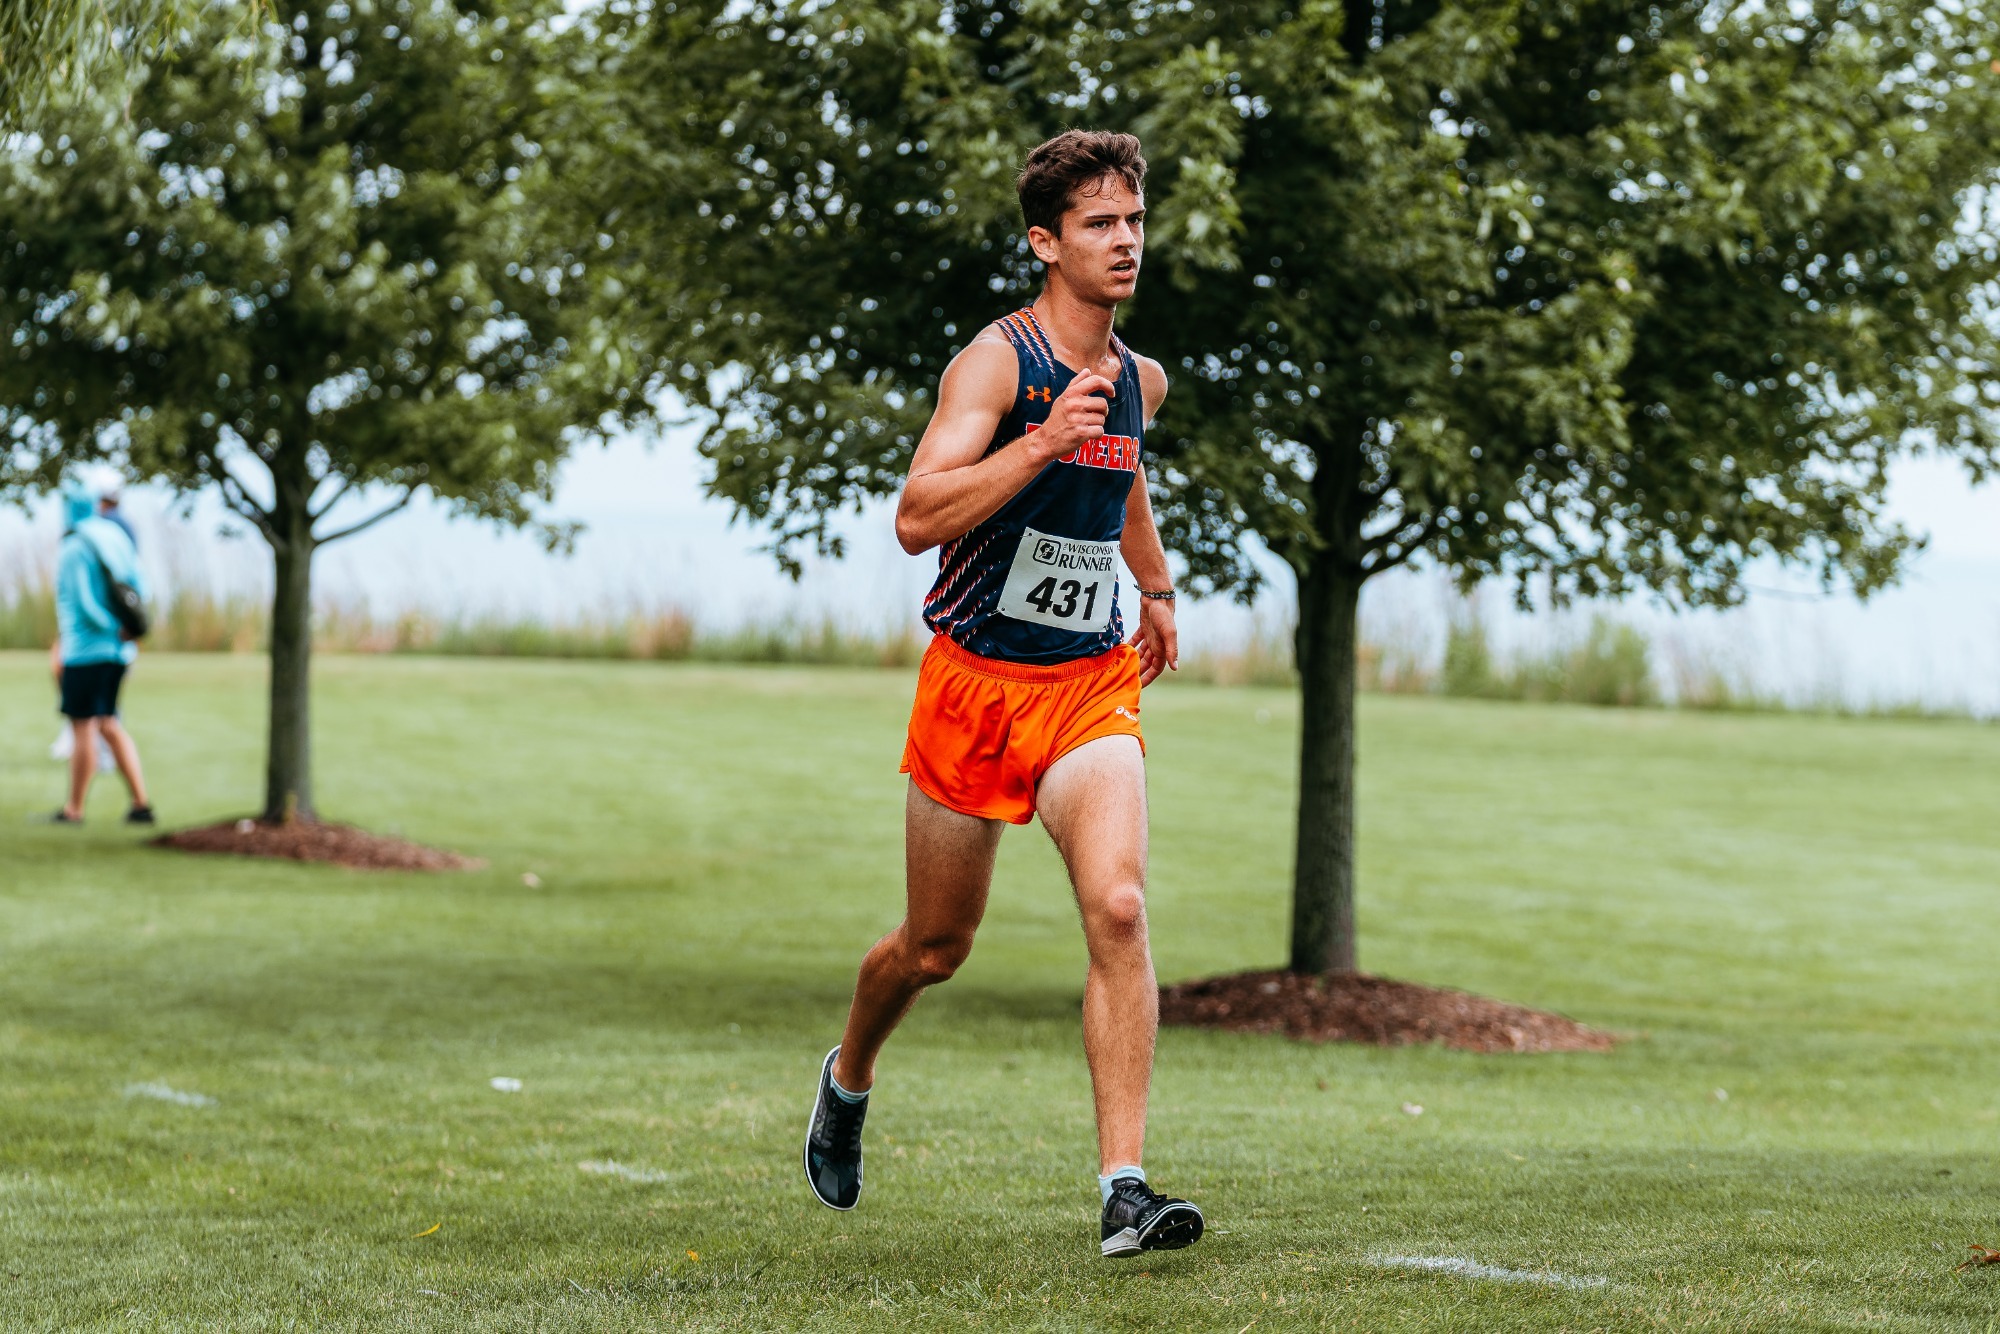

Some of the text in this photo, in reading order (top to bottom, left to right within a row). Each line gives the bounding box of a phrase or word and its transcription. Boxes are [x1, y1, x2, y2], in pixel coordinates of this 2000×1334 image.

[1025, 422, 1139, 473] NEERS
[1058, 553, 1112, 571] RUNNER
[1068, 543, 1114, 555] WISCONSIN
[1025, 576, 1098, 620] 431
